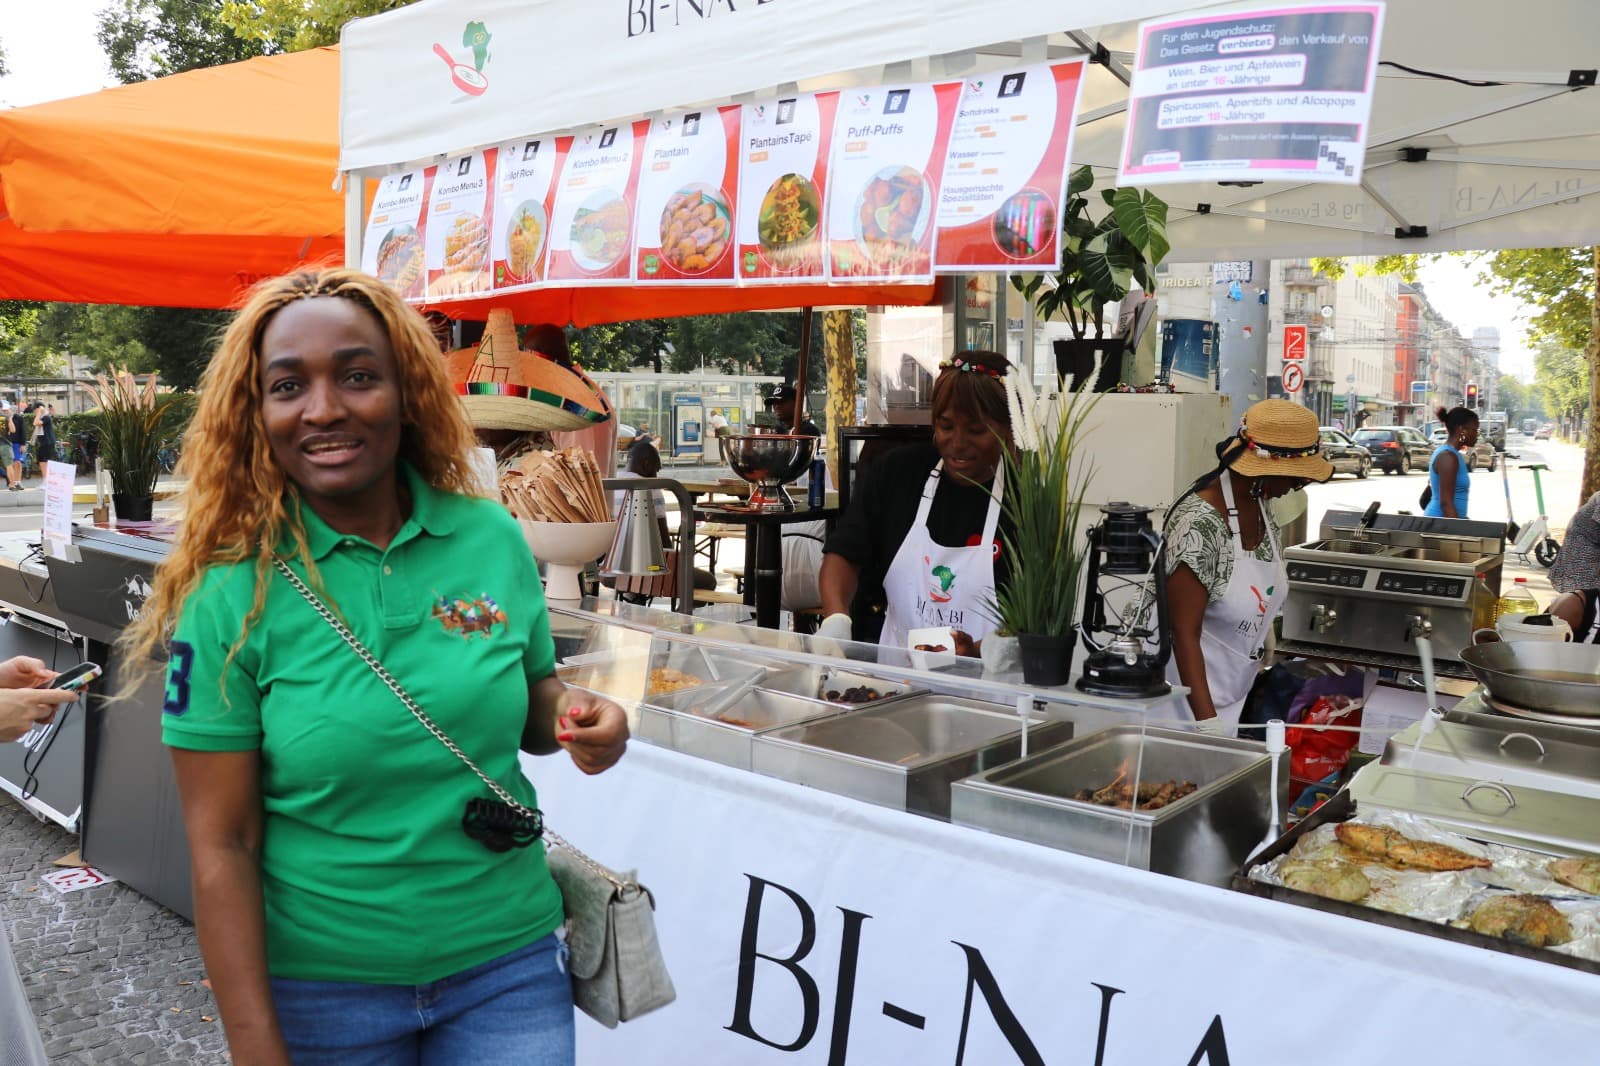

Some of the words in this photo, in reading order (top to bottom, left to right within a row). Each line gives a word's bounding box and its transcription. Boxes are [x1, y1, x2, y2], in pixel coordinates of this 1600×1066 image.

[1180, 31, 1198, 41] den
[1160, 47, 1179, 58] Das
[1181, 43, 1216, 55] Gesetz
[1221, 37, 1273, 50] verbietet
[1278, 34, 1299, 46] den
[1302, 33, 1346, 45] Verkauf
[1348, 34, 1369, 44] von
[1199, 64, 1221, 74] Bier
[1224, 62, 1244, 72] und
[1247, 58, 1302, 72] Apfelwein
[1166, 82, 1178, 91] an
[1181, 79, 1208, 89] unter
[1276, 95, 1298, 106] und
[1302, 95, 1356, 109] Alcopops
[1161, 117, 1173, 126] an
[1176, 115, 1203, 124] unter
[848, 123, 904, 138] Puff-Puffs
[654, 145, 690, 159] Plantain
[949, 151, 979, 160] Wasser
[438, 184, 460, 196] Kombo
[460, 181, 478, 192] Menu
[478, 178, 484, 188] 3
[943, 184, 1004, 195] Hausgemachte
